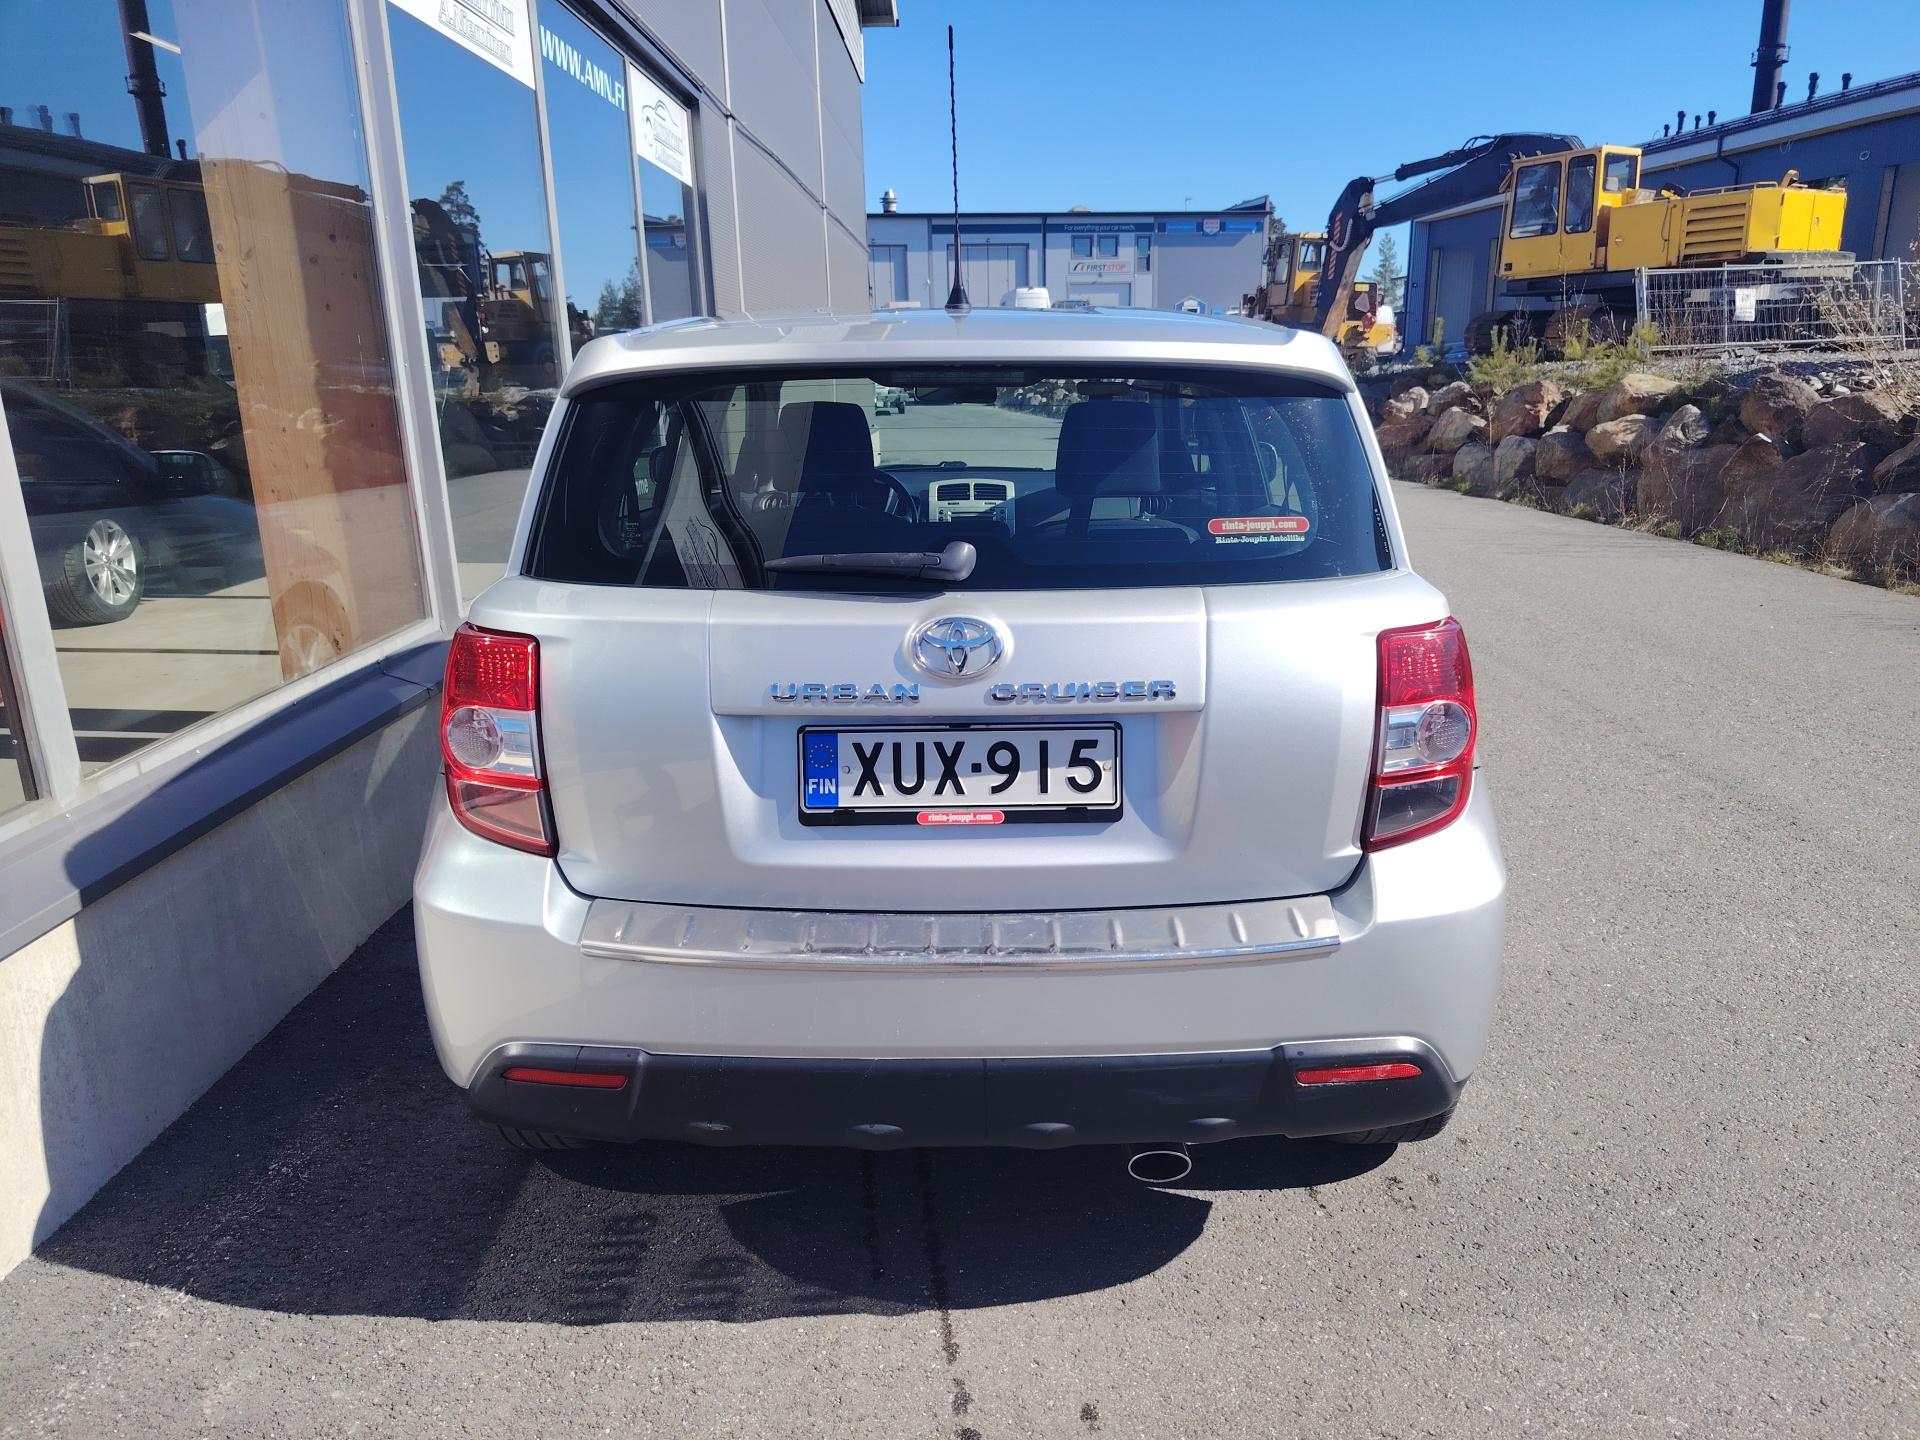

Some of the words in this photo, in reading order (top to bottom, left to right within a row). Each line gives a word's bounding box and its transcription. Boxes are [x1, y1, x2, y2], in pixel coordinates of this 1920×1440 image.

[540, 25, 625, 111] WWW.AMN.FI
[1222, 520, 1297, 531] rinta-jouppi.com
[770, 682, 920, 703] URBAN
[990, 680, 1176, 702] CRUISER
[851, 739, 1103, 797] XUX-915
[808, 778, 836, 795] FIN
[928, 813, 993, 823] rinta-jouppi.com
